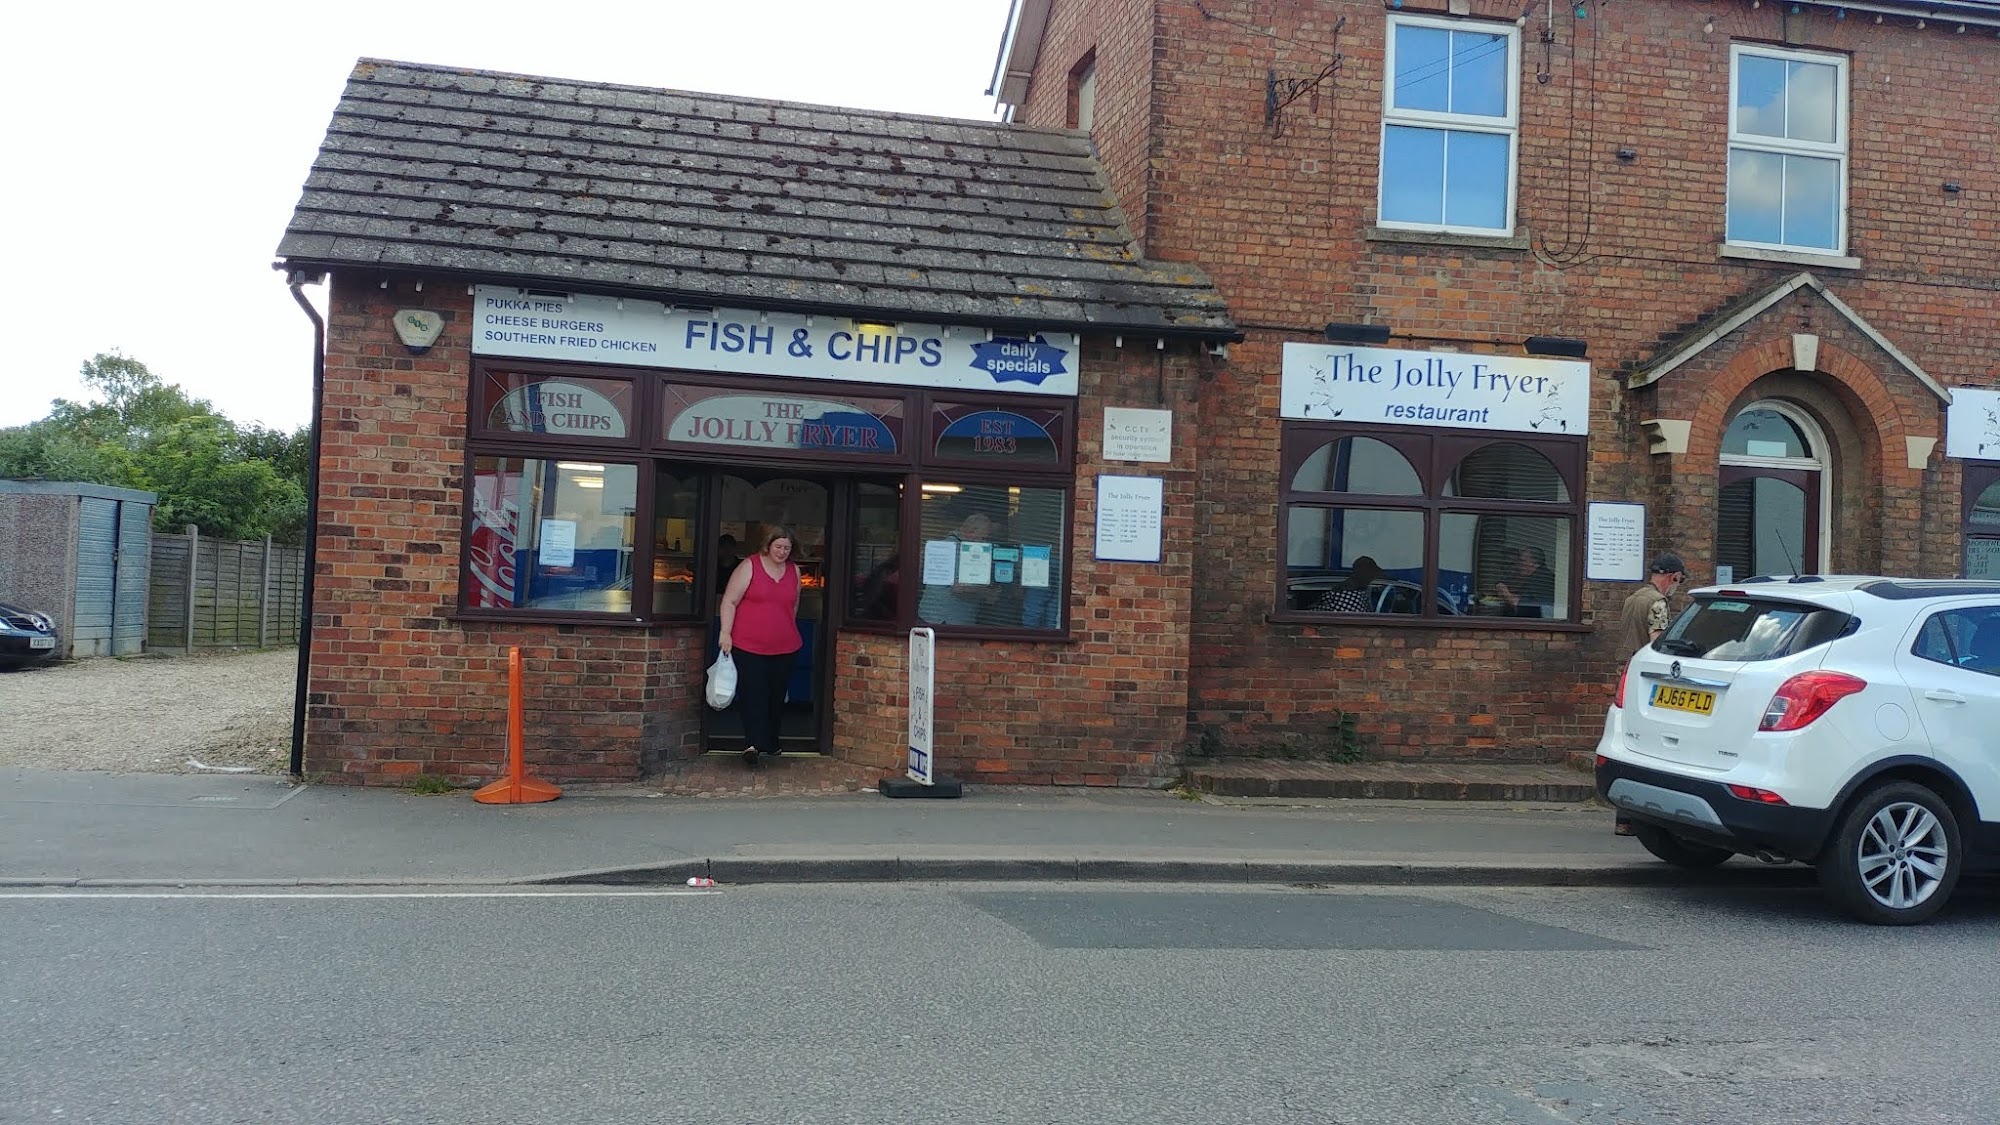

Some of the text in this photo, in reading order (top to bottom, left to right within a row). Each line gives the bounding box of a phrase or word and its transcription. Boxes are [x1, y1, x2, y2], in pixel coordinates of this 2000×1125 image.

[486, 298, 564, 314] PUKKA PIES
[486, 314, 604, 333] CHEESE BURGERS
[485, 330, 657, 353] SOUTHERN FRIED CHICKEN
[685, 319, 943, 368] FISH & CHIPS
[1001, 342, 1038, 360] daily
[986, 357, 1051, 375] specials
[1326, 353, 1550, 403] The Jolly Fryer
[535, 390, 583, 410] FISH
[762, 402, 805, 420] THE
[1385, 403, 1489, 424] restaurant
[502, 411, 612, 431] AND CHIPS
[980, 418, 1016, 435] EST
[688, 415, 879, 450] JOLLY FRYER
[974, 436, 1017, 455] 1983
[1656, 688, 1712, 711] AJ66 FLD
[914, 724, 926, 742] CHIPS
